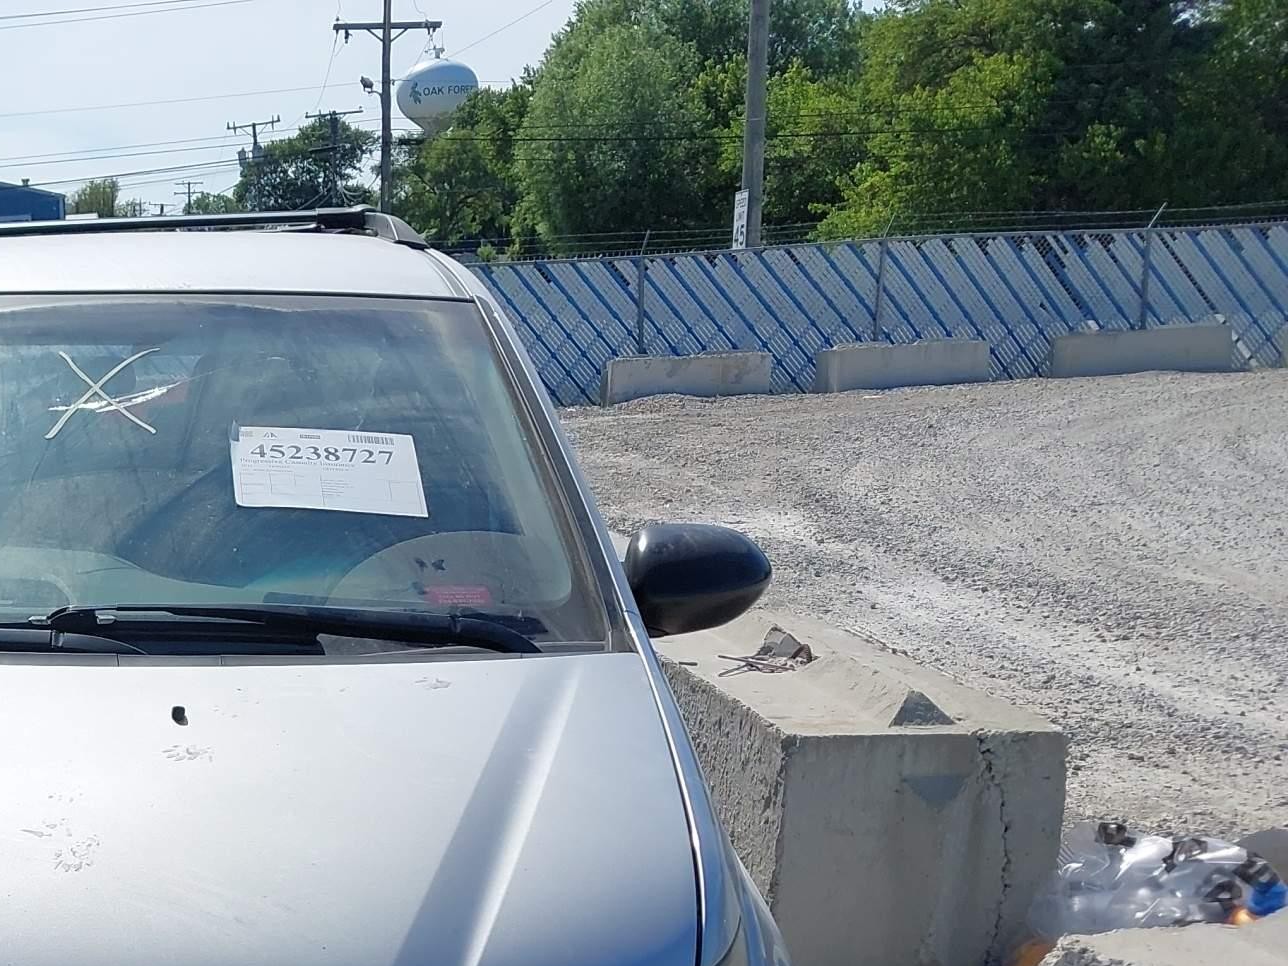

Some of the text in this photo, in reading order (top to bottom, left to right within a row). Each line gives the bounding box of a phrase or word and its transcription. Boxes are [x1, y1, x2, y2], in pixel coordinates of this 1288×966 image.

[423, 86, 444, 96] OAK
[734, 224, 745, 247] 45
[250, 443, 394, 465] 45238727
